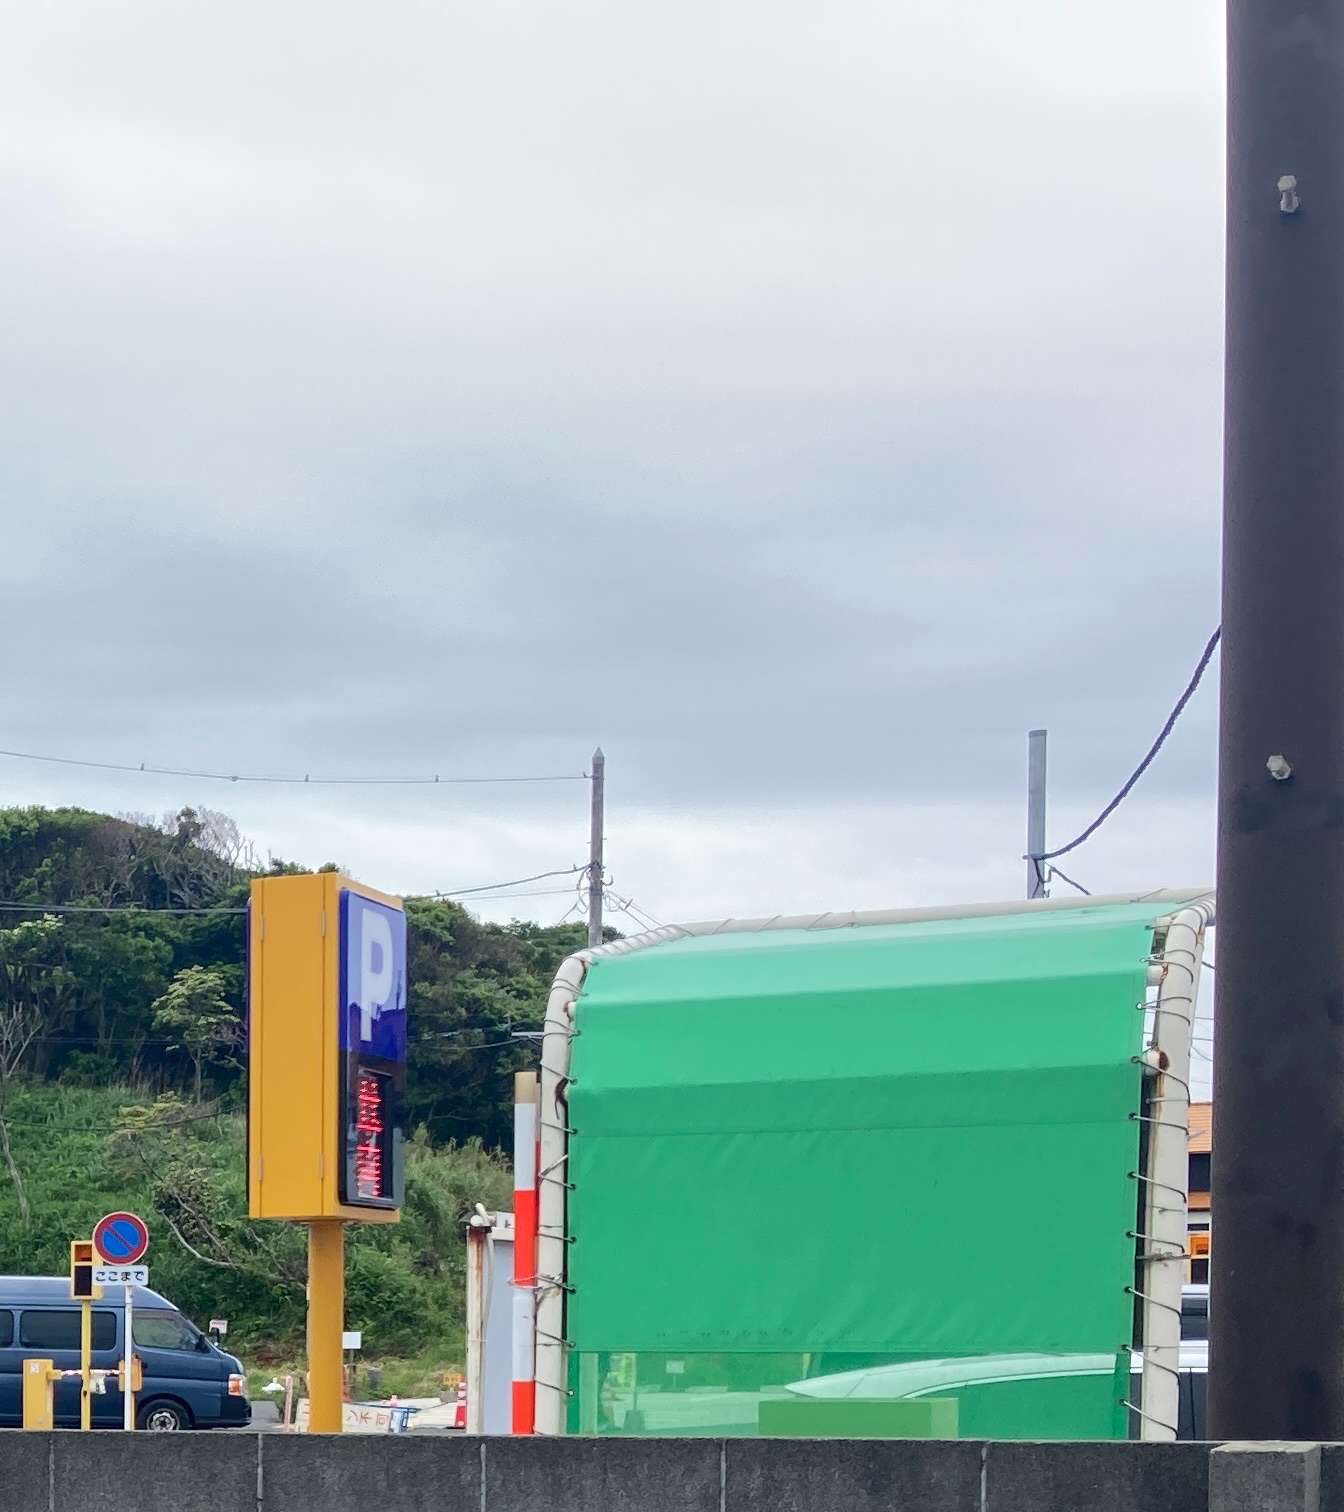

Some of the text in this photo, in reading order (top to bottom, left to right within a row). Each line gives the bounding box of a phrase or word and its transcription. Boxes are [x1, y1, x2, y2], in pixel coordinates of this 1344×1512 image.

[360, 907, 393, 1042] P
[95, 1271, 145, 1282] ここまで
